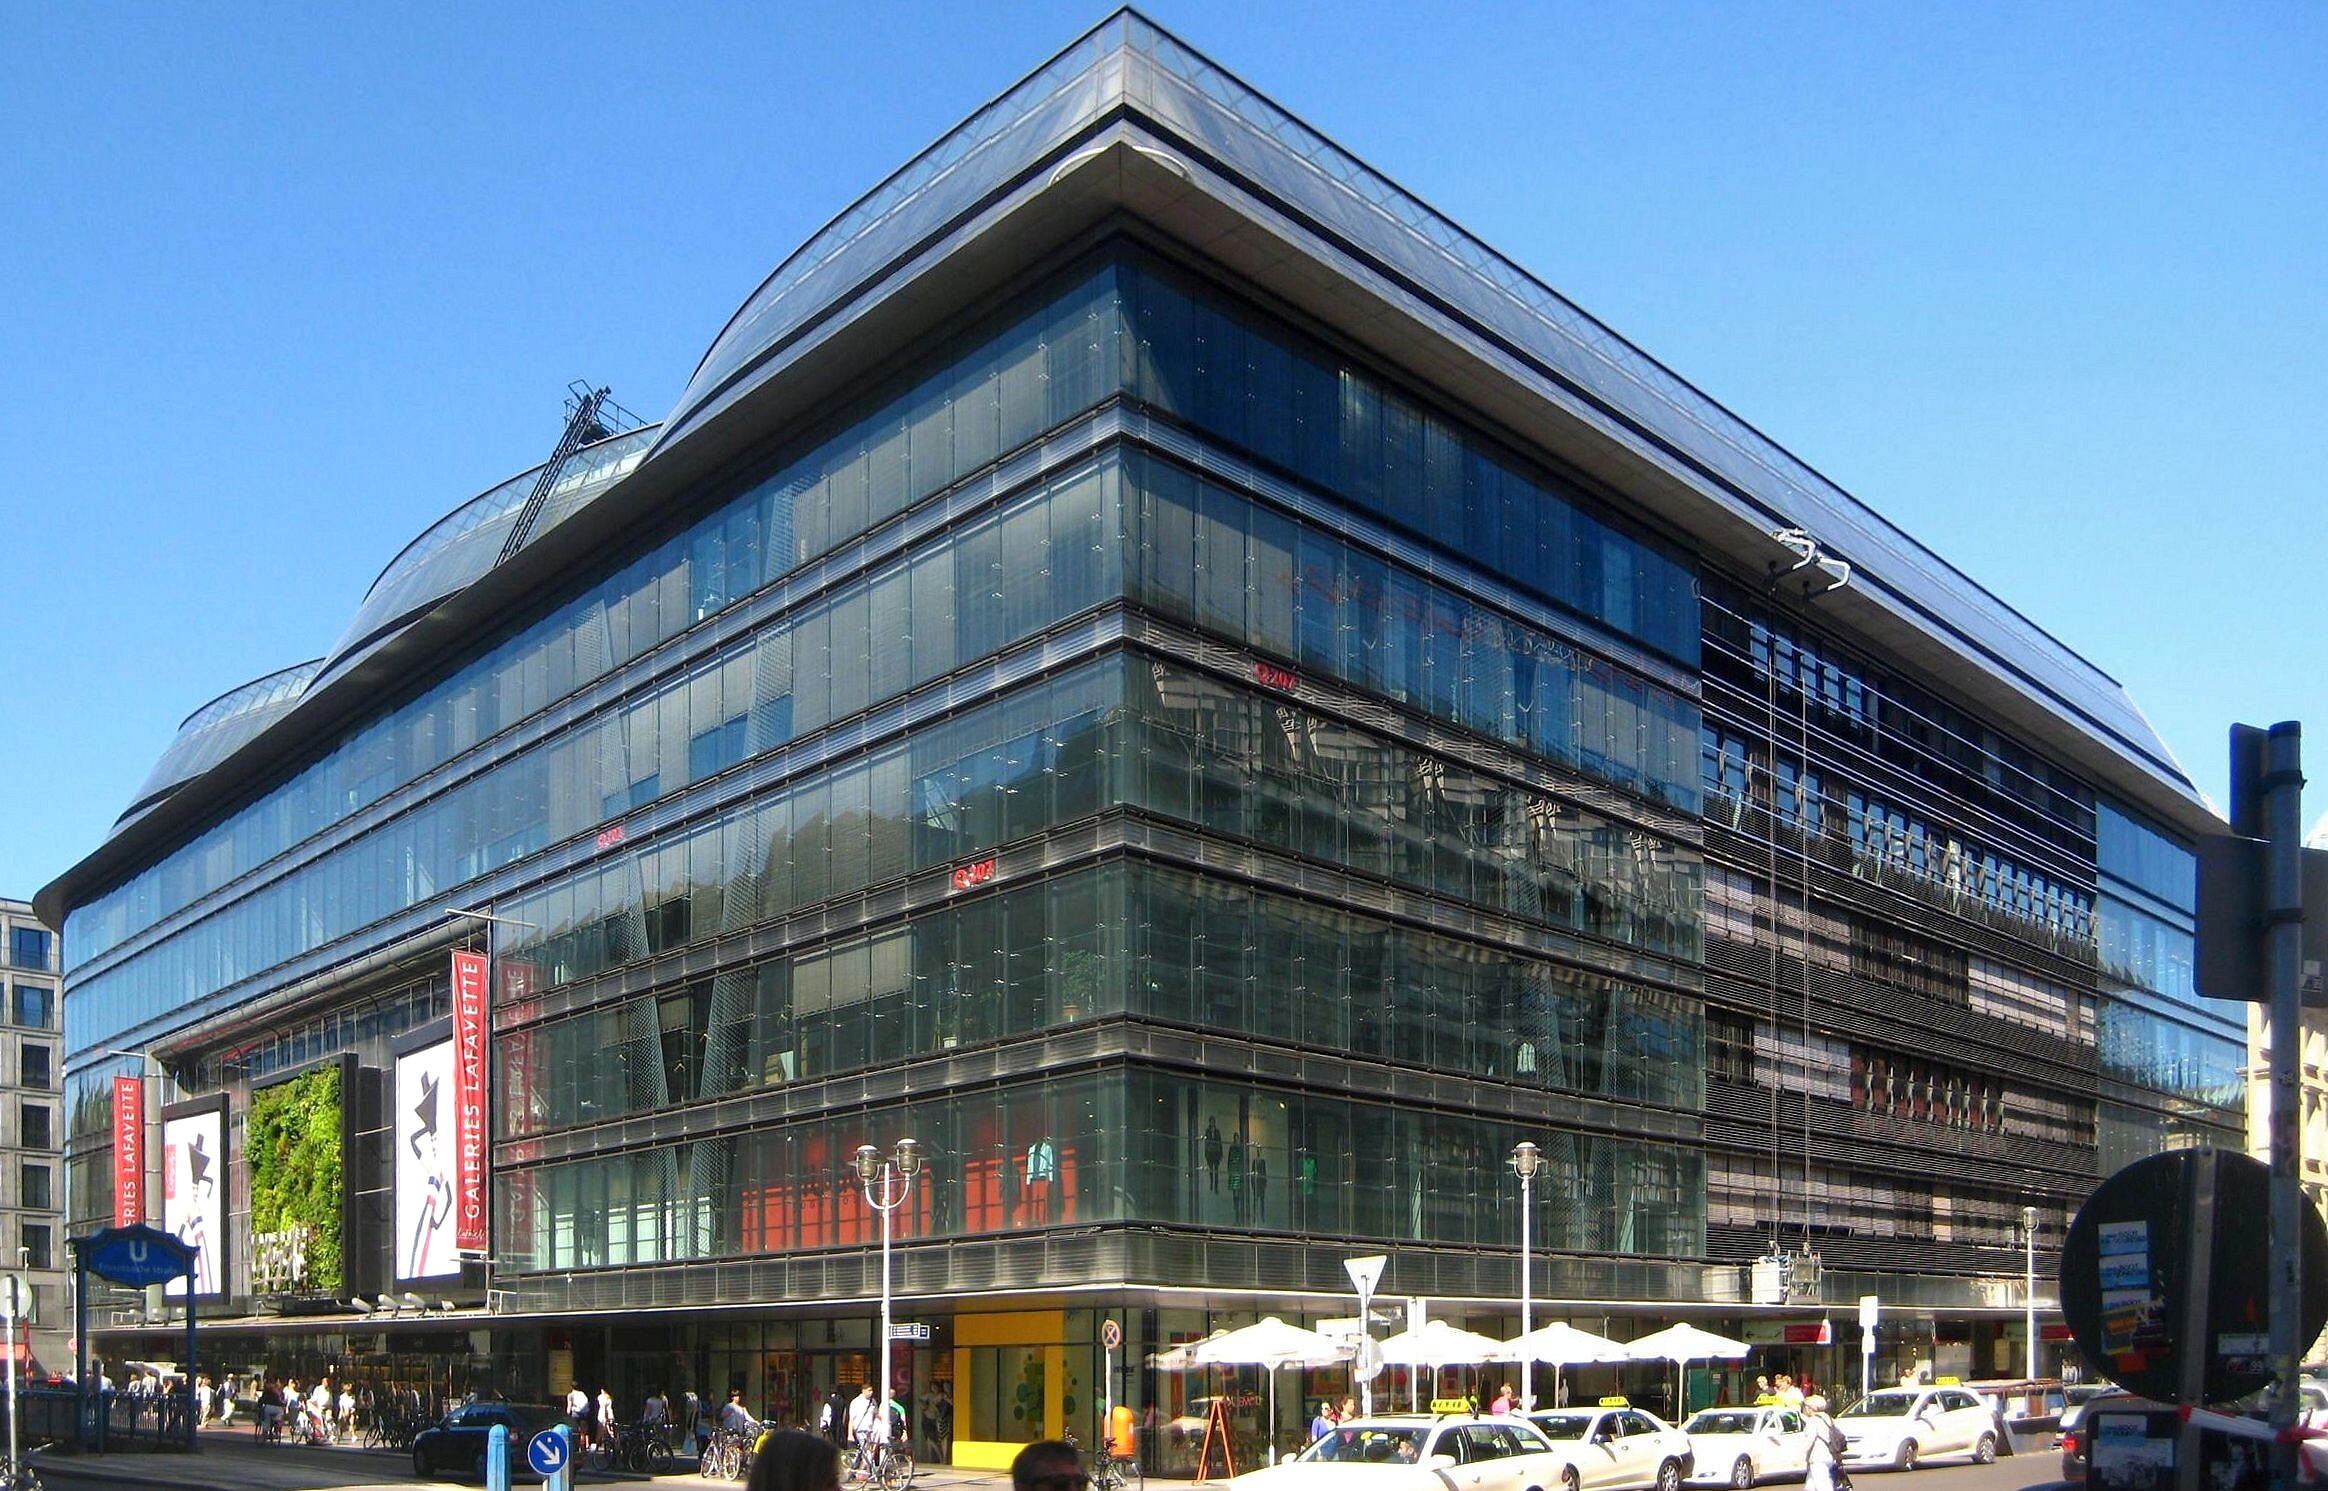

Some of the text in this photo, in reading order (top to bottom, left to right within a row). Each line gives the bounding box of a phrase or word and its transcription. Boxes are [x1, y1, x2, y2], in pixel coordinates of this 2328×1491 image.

[462, 960, 480, 1092] LAFAYETTE
[121, 1083, 136, 1227] ERIES LAFAYETTE
[463, 1104, 480, 1219] GALERIES
[129, 1240, 147, 1262] U
